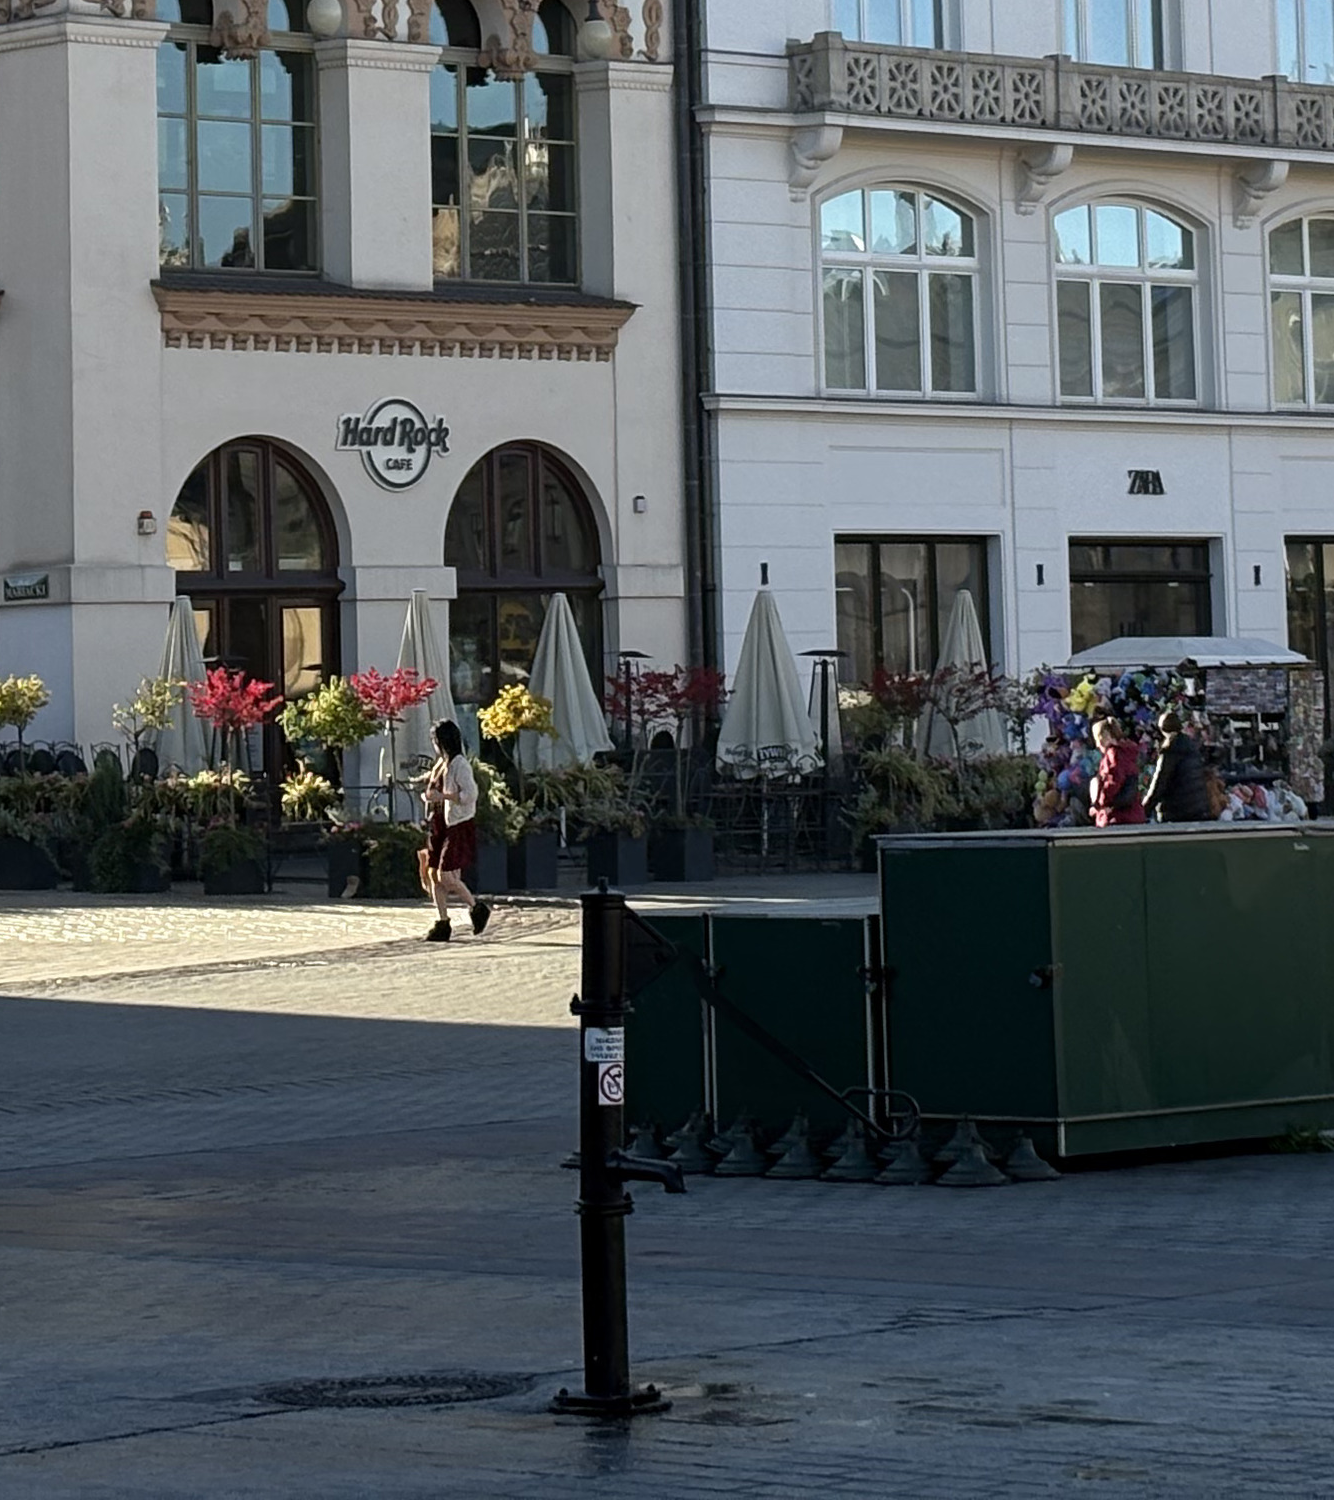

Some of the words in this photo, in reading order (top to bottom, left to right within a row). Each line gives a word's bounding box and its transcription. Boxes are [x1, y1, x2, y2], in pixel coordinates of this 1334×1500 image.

[340, 416, 398, 447] Hard
[397, 417, 450, 454] Rock
[385, 457, 414, 471] CAFE
